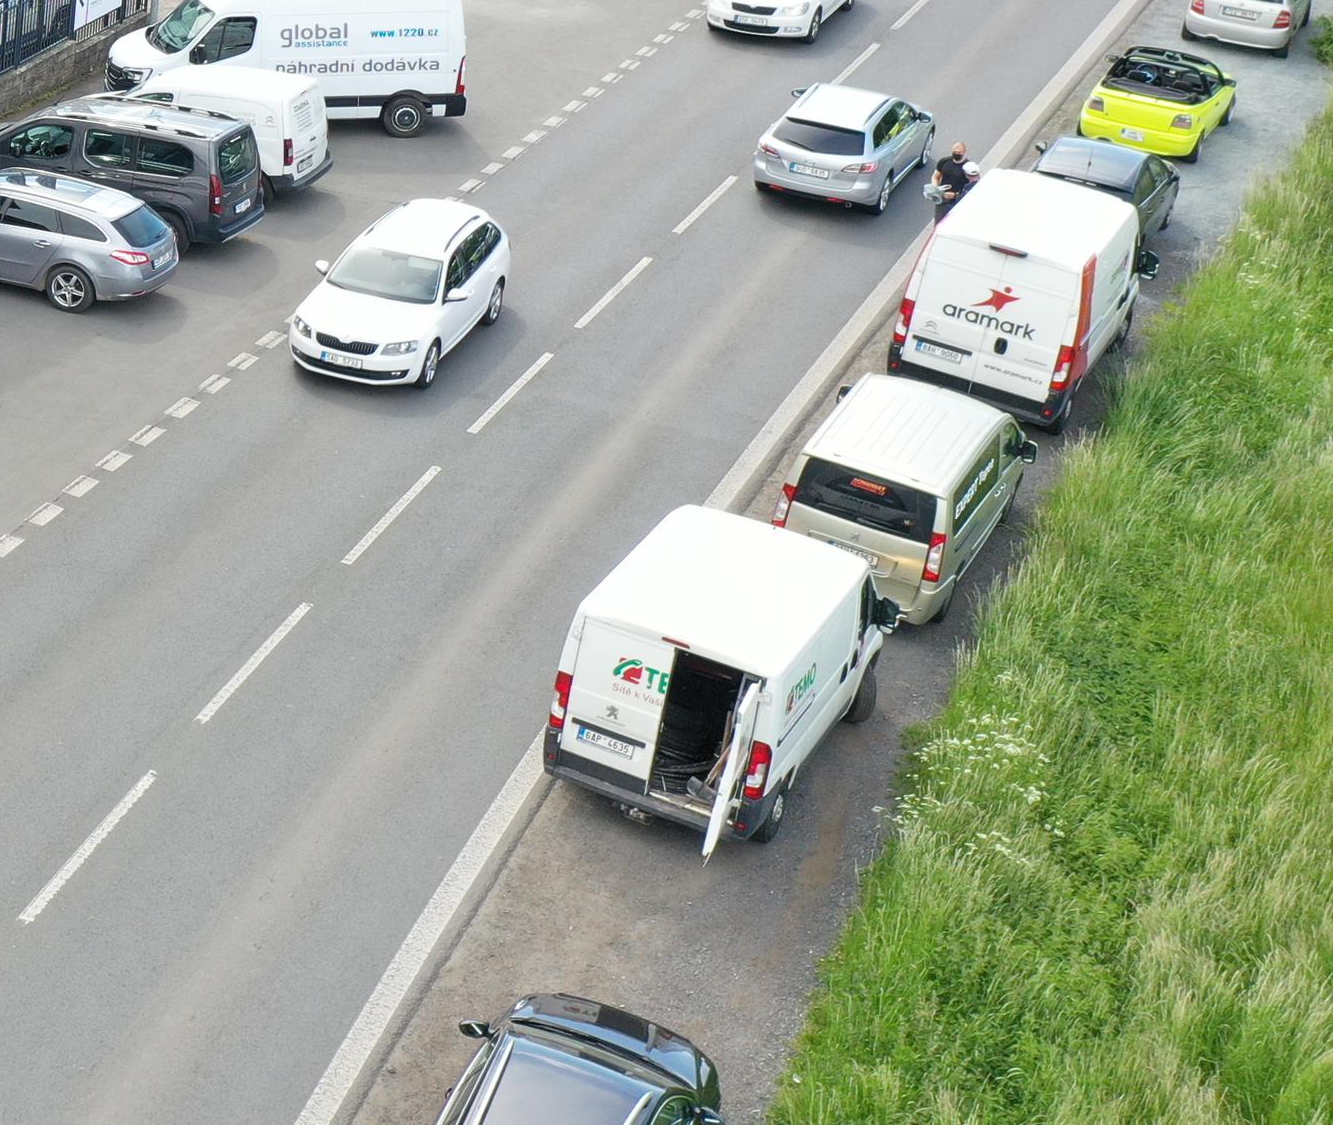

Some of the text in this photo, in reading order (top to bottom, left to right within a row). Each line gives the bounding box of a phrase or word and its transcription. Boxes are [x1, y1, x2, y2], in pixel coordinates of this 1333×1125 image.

[280, 22, 348, 48] global
[370, 28, 439, 38] www.1220.cz
[294, 39, 349, 49] assistance
[276, 57, 440, 74] náhradní dodávka
[942, 303, 1036, 341] aramark
[585, 731, 629, 754] 6AP 4635
